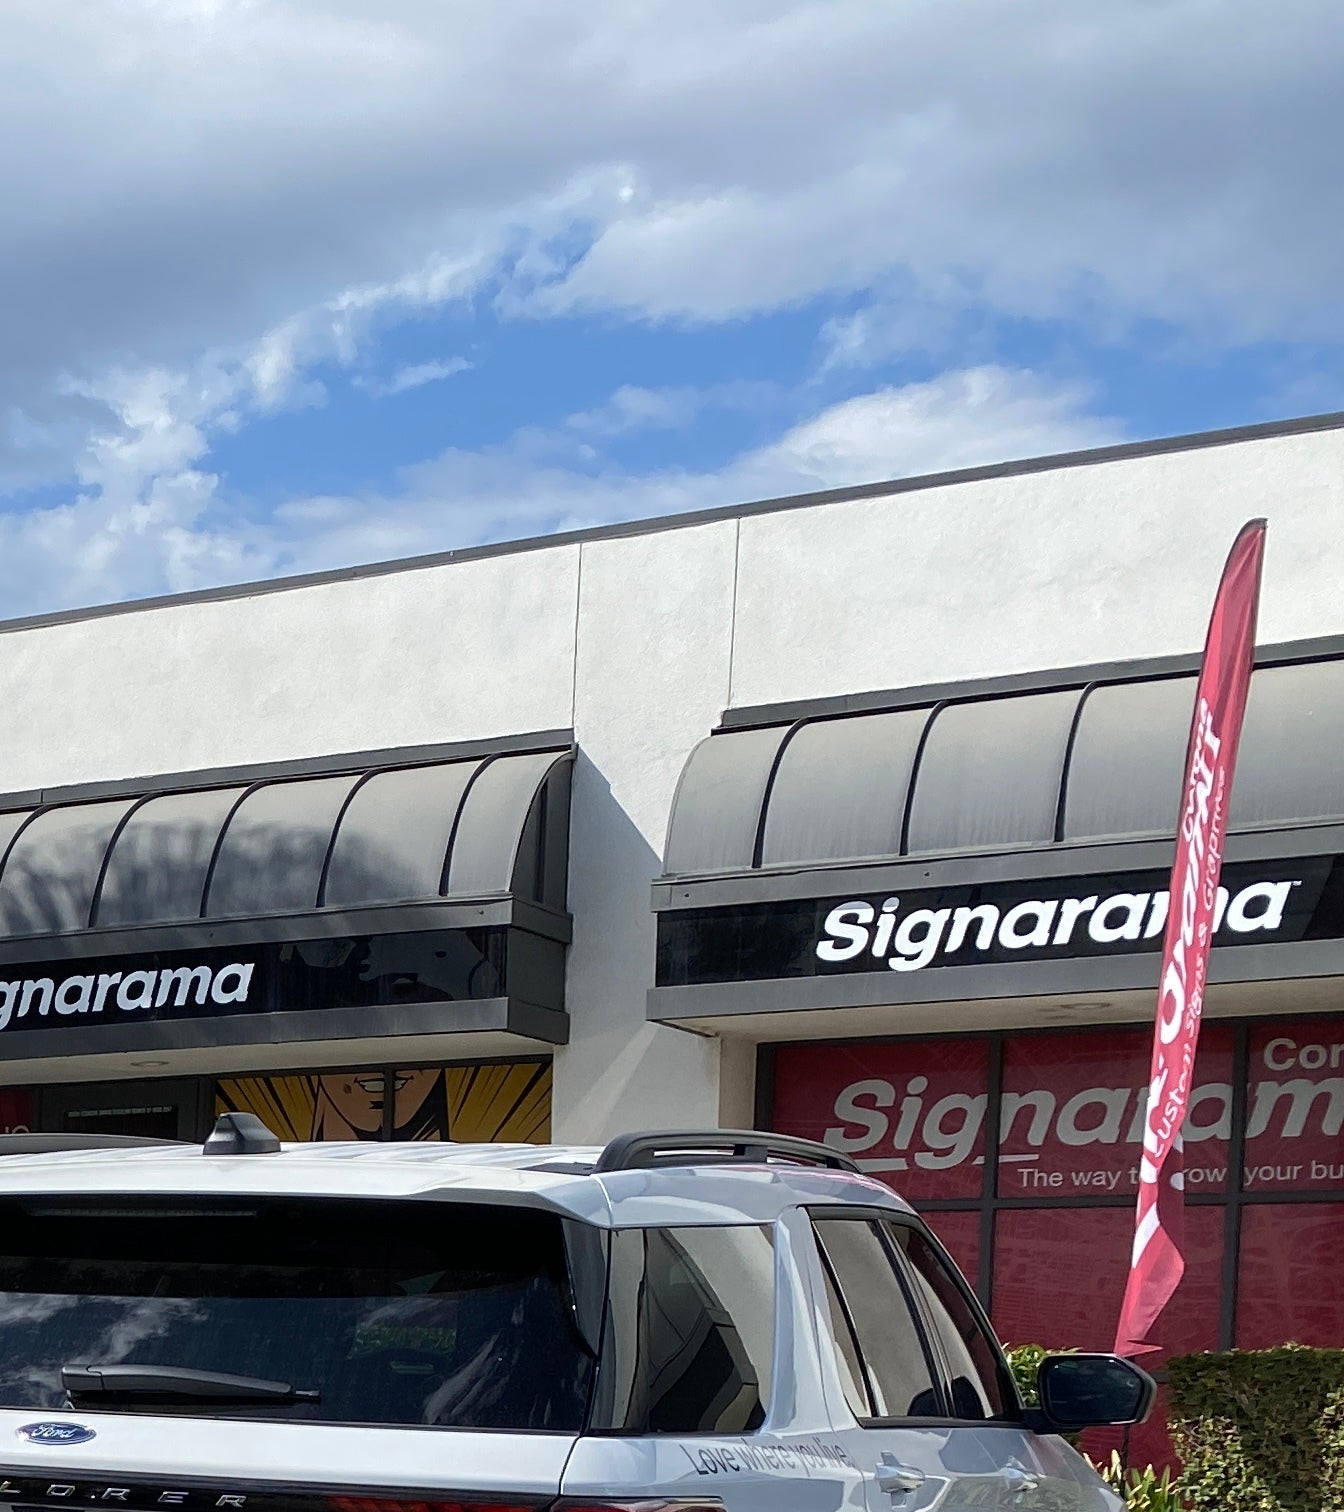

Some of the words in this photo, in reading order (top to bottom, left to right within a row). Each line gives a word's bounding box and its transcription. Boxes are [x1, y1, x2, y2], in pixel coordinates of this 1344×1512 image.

[1018, 1168, 1063, 1187] The
[1071, 1170, 1121, 1190] way
[1244, 1164, 1303, 1186] your
[679, 1443, 741, 1476] Love
[733, 1437, 796, 1471] where
[791, 1444, 826, 1477] you
